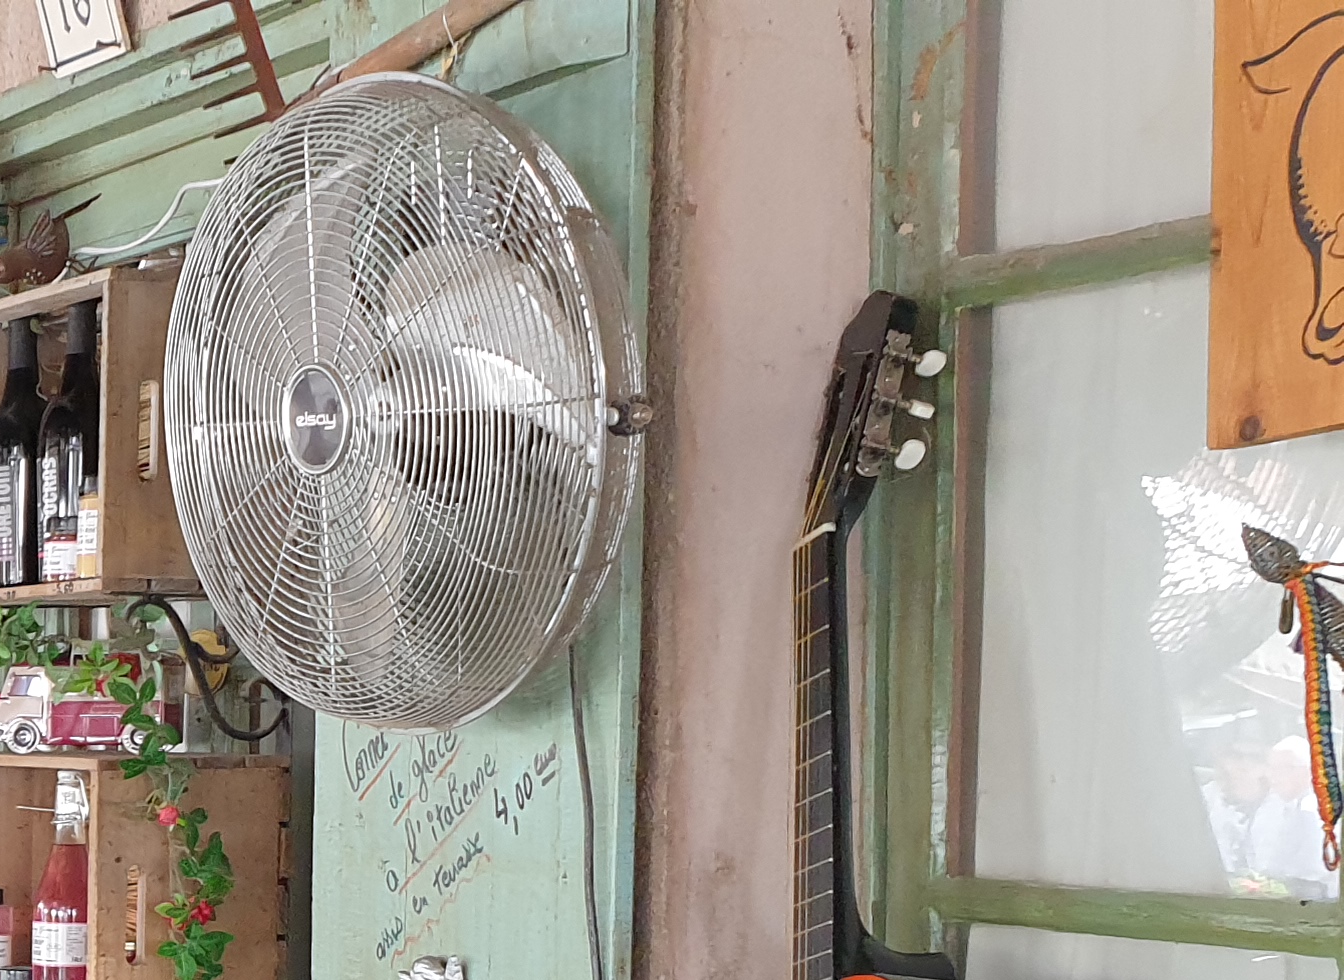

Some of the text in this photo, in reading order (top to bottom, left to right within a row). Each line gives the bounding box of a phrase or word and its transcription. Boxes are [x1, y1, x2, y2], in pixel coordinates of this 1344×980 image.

[296, 411, 336, 430] elsay
[389, 770, 405, 809] de
[412, 895, 429, 914] en
